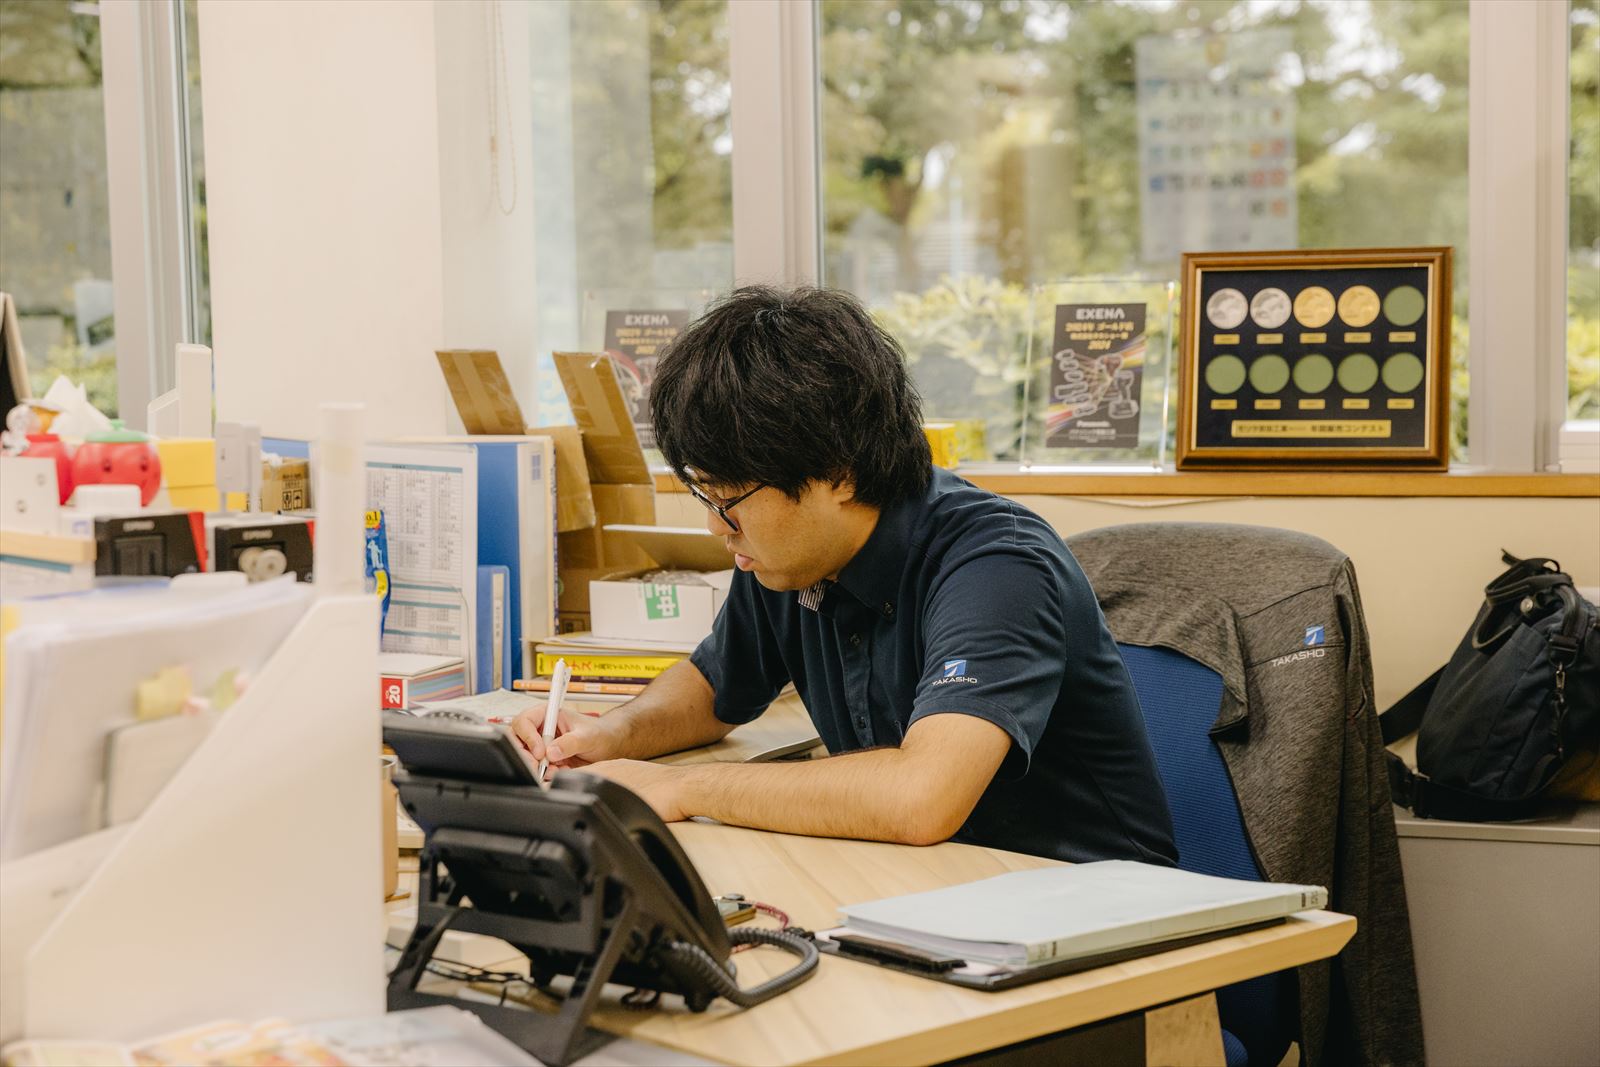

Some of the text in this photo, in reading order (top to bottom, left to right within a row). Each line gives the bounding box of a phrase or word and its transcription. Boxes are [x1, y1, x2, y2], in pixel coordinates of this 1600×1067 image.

[1271, 648, 1325, 667] TAKASHO
[931, 676, 978, 686] TAKASHO
[388, 684, 401, 704] 20
